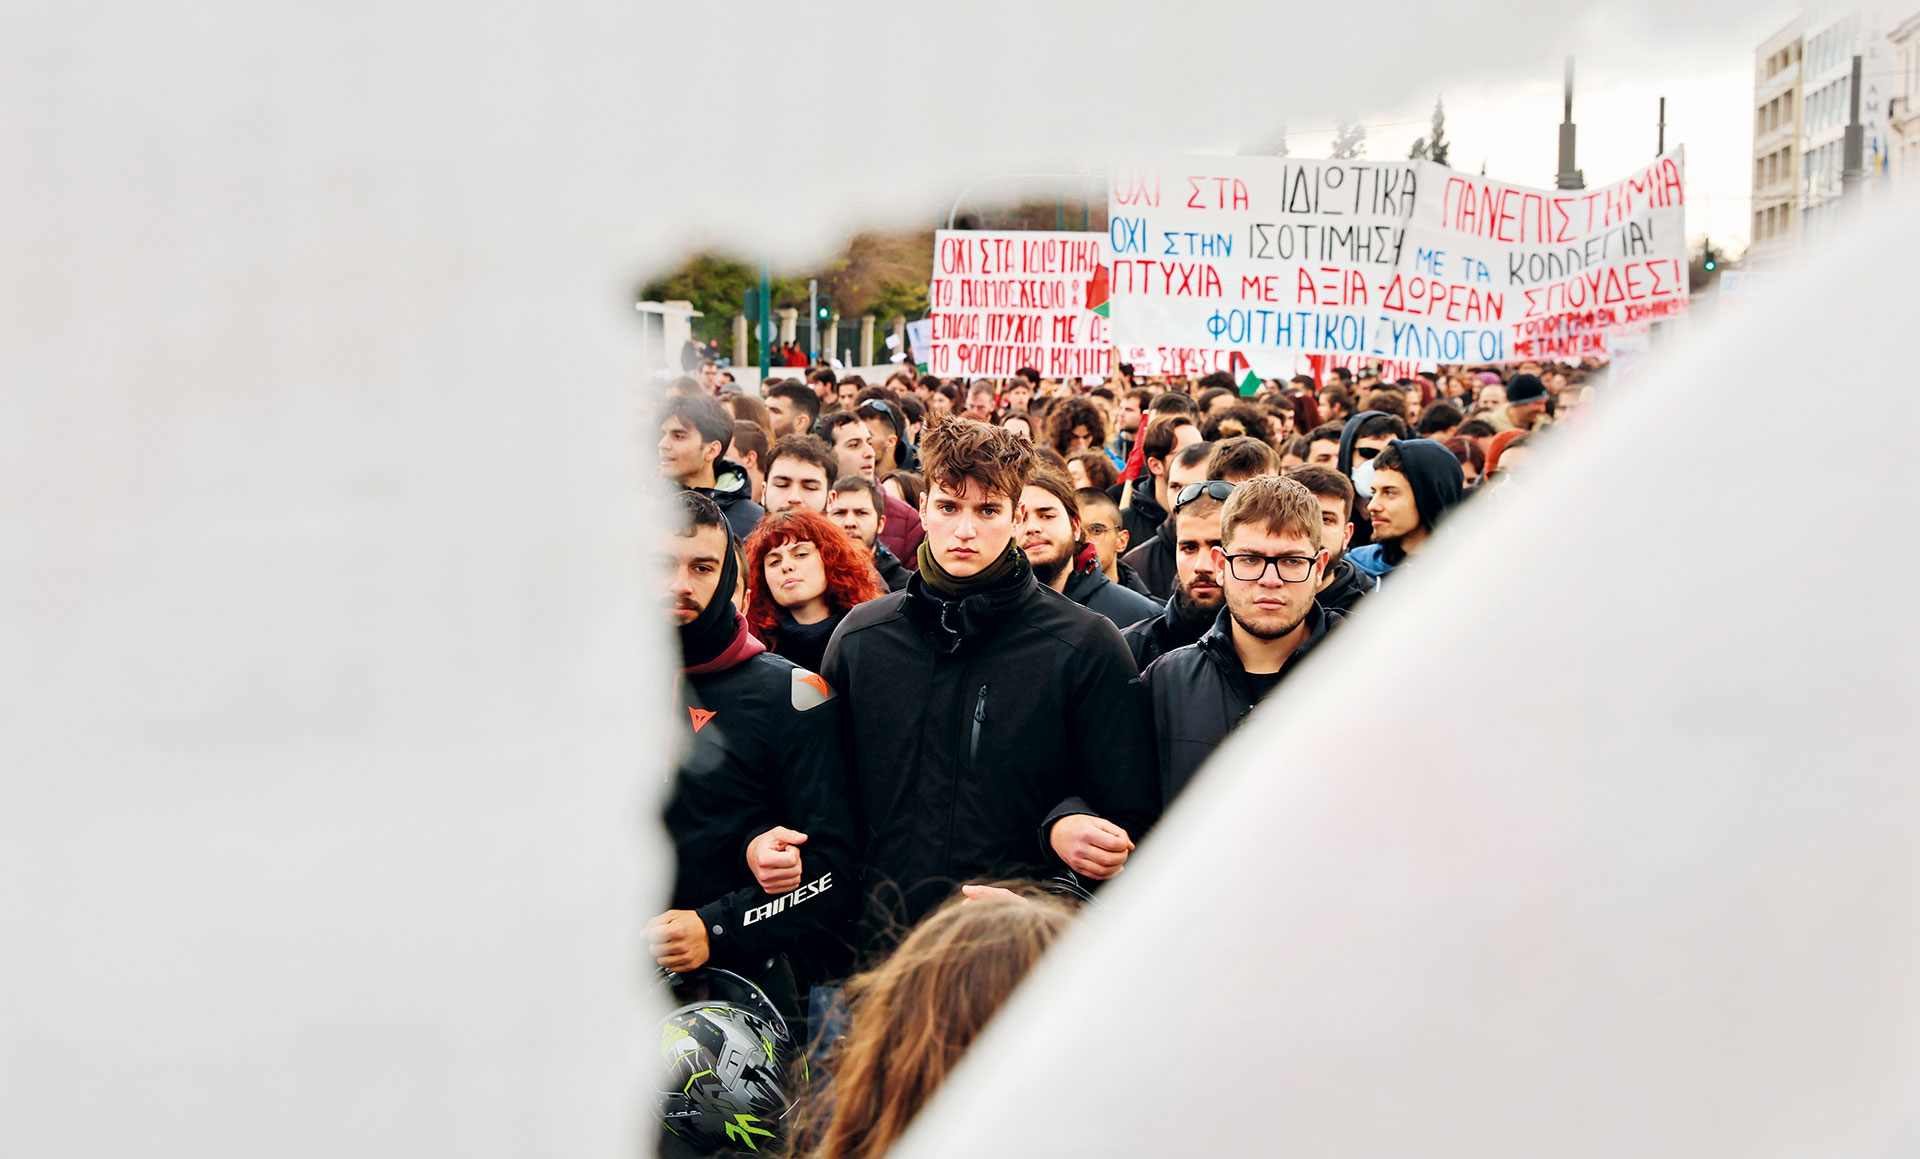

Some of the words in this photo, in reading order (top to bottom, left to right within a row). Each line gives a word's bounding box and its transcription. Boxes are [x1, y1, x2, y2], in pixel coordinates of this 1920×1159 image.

[1186, 176, 1249, 211] ΣΤΑ
[1282, 165, 1417, 218] ΙΔΙΩΤΙΚΑ
[1442, 157, 1684, 244] ΠΑΝΕΠΙΣΤΗΜΙΑ
[942, 237, 972, 274] ΟΧΙ
[980, 239, 1015, 274] ΣΤΑ
[1023, 239, 1100, 274] ΙΔΙΩΤΙΚΑ
[1111, 216, 1147, 254] ΟΧΙ
[1163, 232, 1233, 257] ΣΤΗΝ
[1415, 248, 1446, 277] ΜΕ
[1462, 256, 1492, 283] ΤΑ
[934, 279, 952, 307] ΤΟ
[1112, 260, 1222, 298] ΠΤΥΧΙΑ
[1242, 276, 1280, 302] ΜΕ
[1298, 267, 1368, 305] ΑΞΙΑ
[1524, 259, 1683, 318] ΣΠΟΥΔΕΣ!
[986, 313, 1043, 343] ΠΤΥΧΙΑ
[1053, 315, 1078, 343] ΜΕ
[1207, 309, 1365, 352] ΦΟΙΤΗΤΙΚΟΙ
[931, 344, 949, 374] ΤΟ
[743, 872, 832, 927] DAINESE
